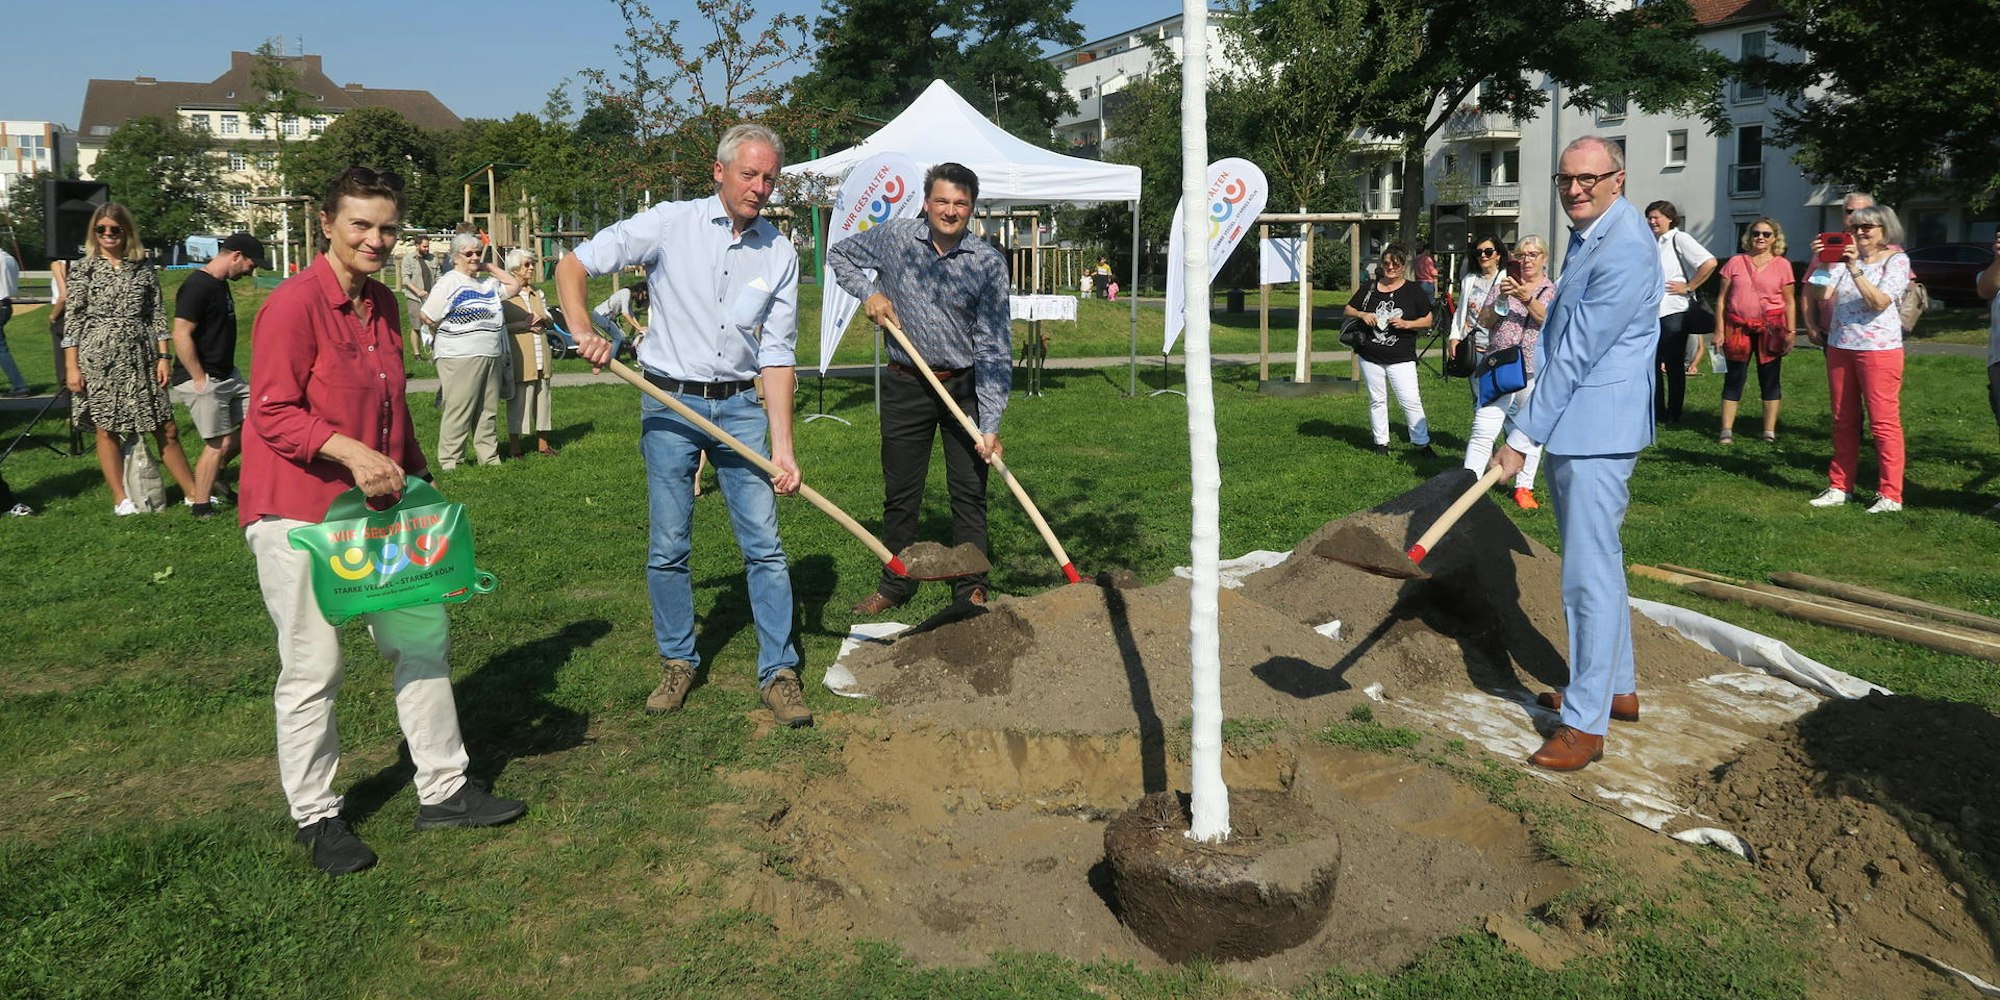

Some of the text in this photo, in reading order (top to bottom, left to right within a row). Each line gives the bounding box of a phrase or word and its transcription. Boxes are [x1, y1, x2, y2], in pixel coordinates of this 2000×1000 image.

[841, 212, 857, 231] WIR
[333, 586, 362, 595] STARKE
[401, 572, 433, 585] STARKES
